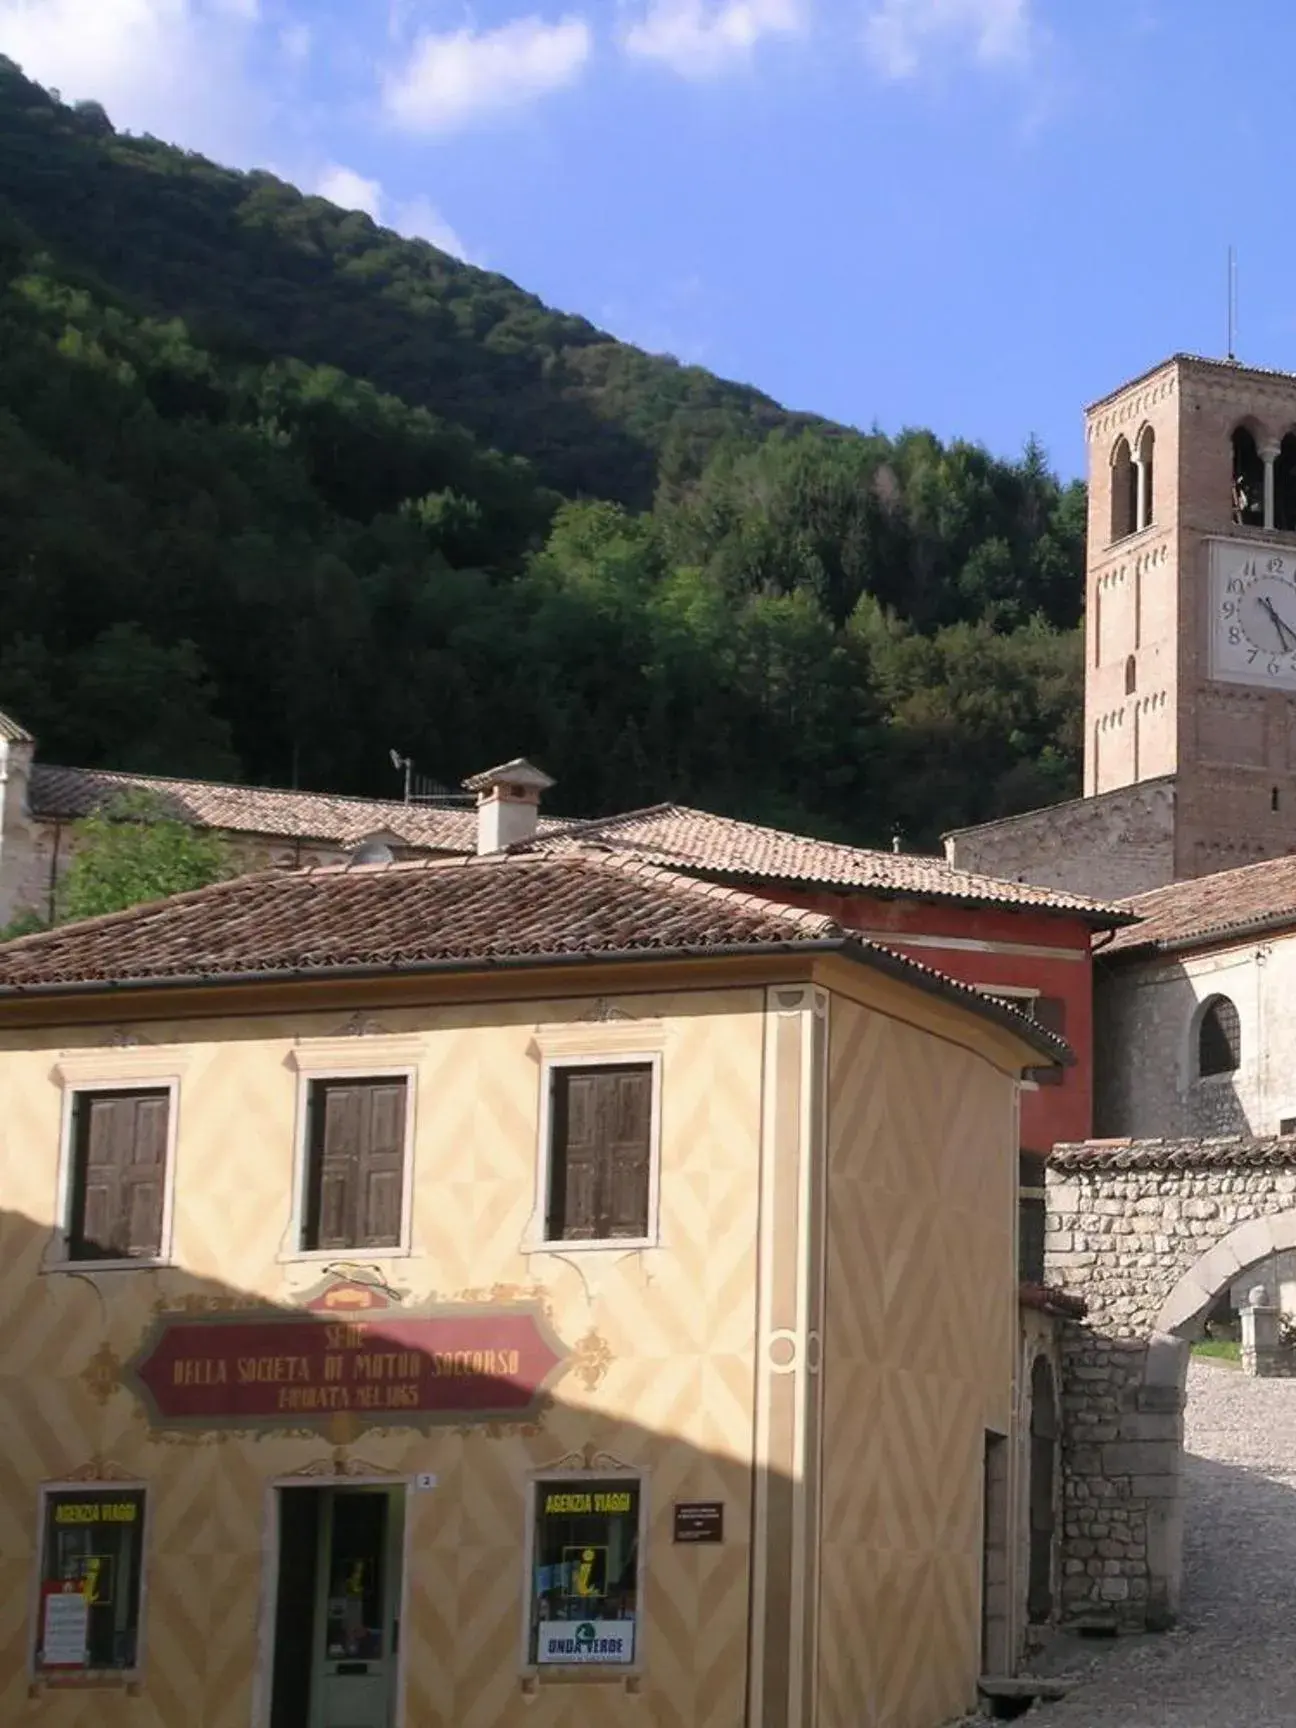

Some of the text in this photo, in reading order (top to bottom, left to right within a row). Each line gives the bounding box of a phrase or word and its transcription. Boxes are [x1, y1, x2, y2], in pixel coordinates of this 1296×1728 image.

[1244, 561, 1256, 576] 11
[1266, 558, 1284, 573] 12
[1226, 578, 1243, 594] 10
[1222, 602, 1235, 619] 9
[1228, 627, 1240, 645] 8
[1247, 649, 1258, 664] 7
[1267, 654, 1280, 675] 6
[174, 1358, 227, 1385] DELLA
[325, 1354, 344, 1382] DI
[431, 1349, 520, 1378] SOCCORSO
[545, 1492, 631, 1513] AGENZIA VIAGGI
[55, 1504, 99, 1522] AGENZIA
[585, 1638, 623, 1654] VERDE
